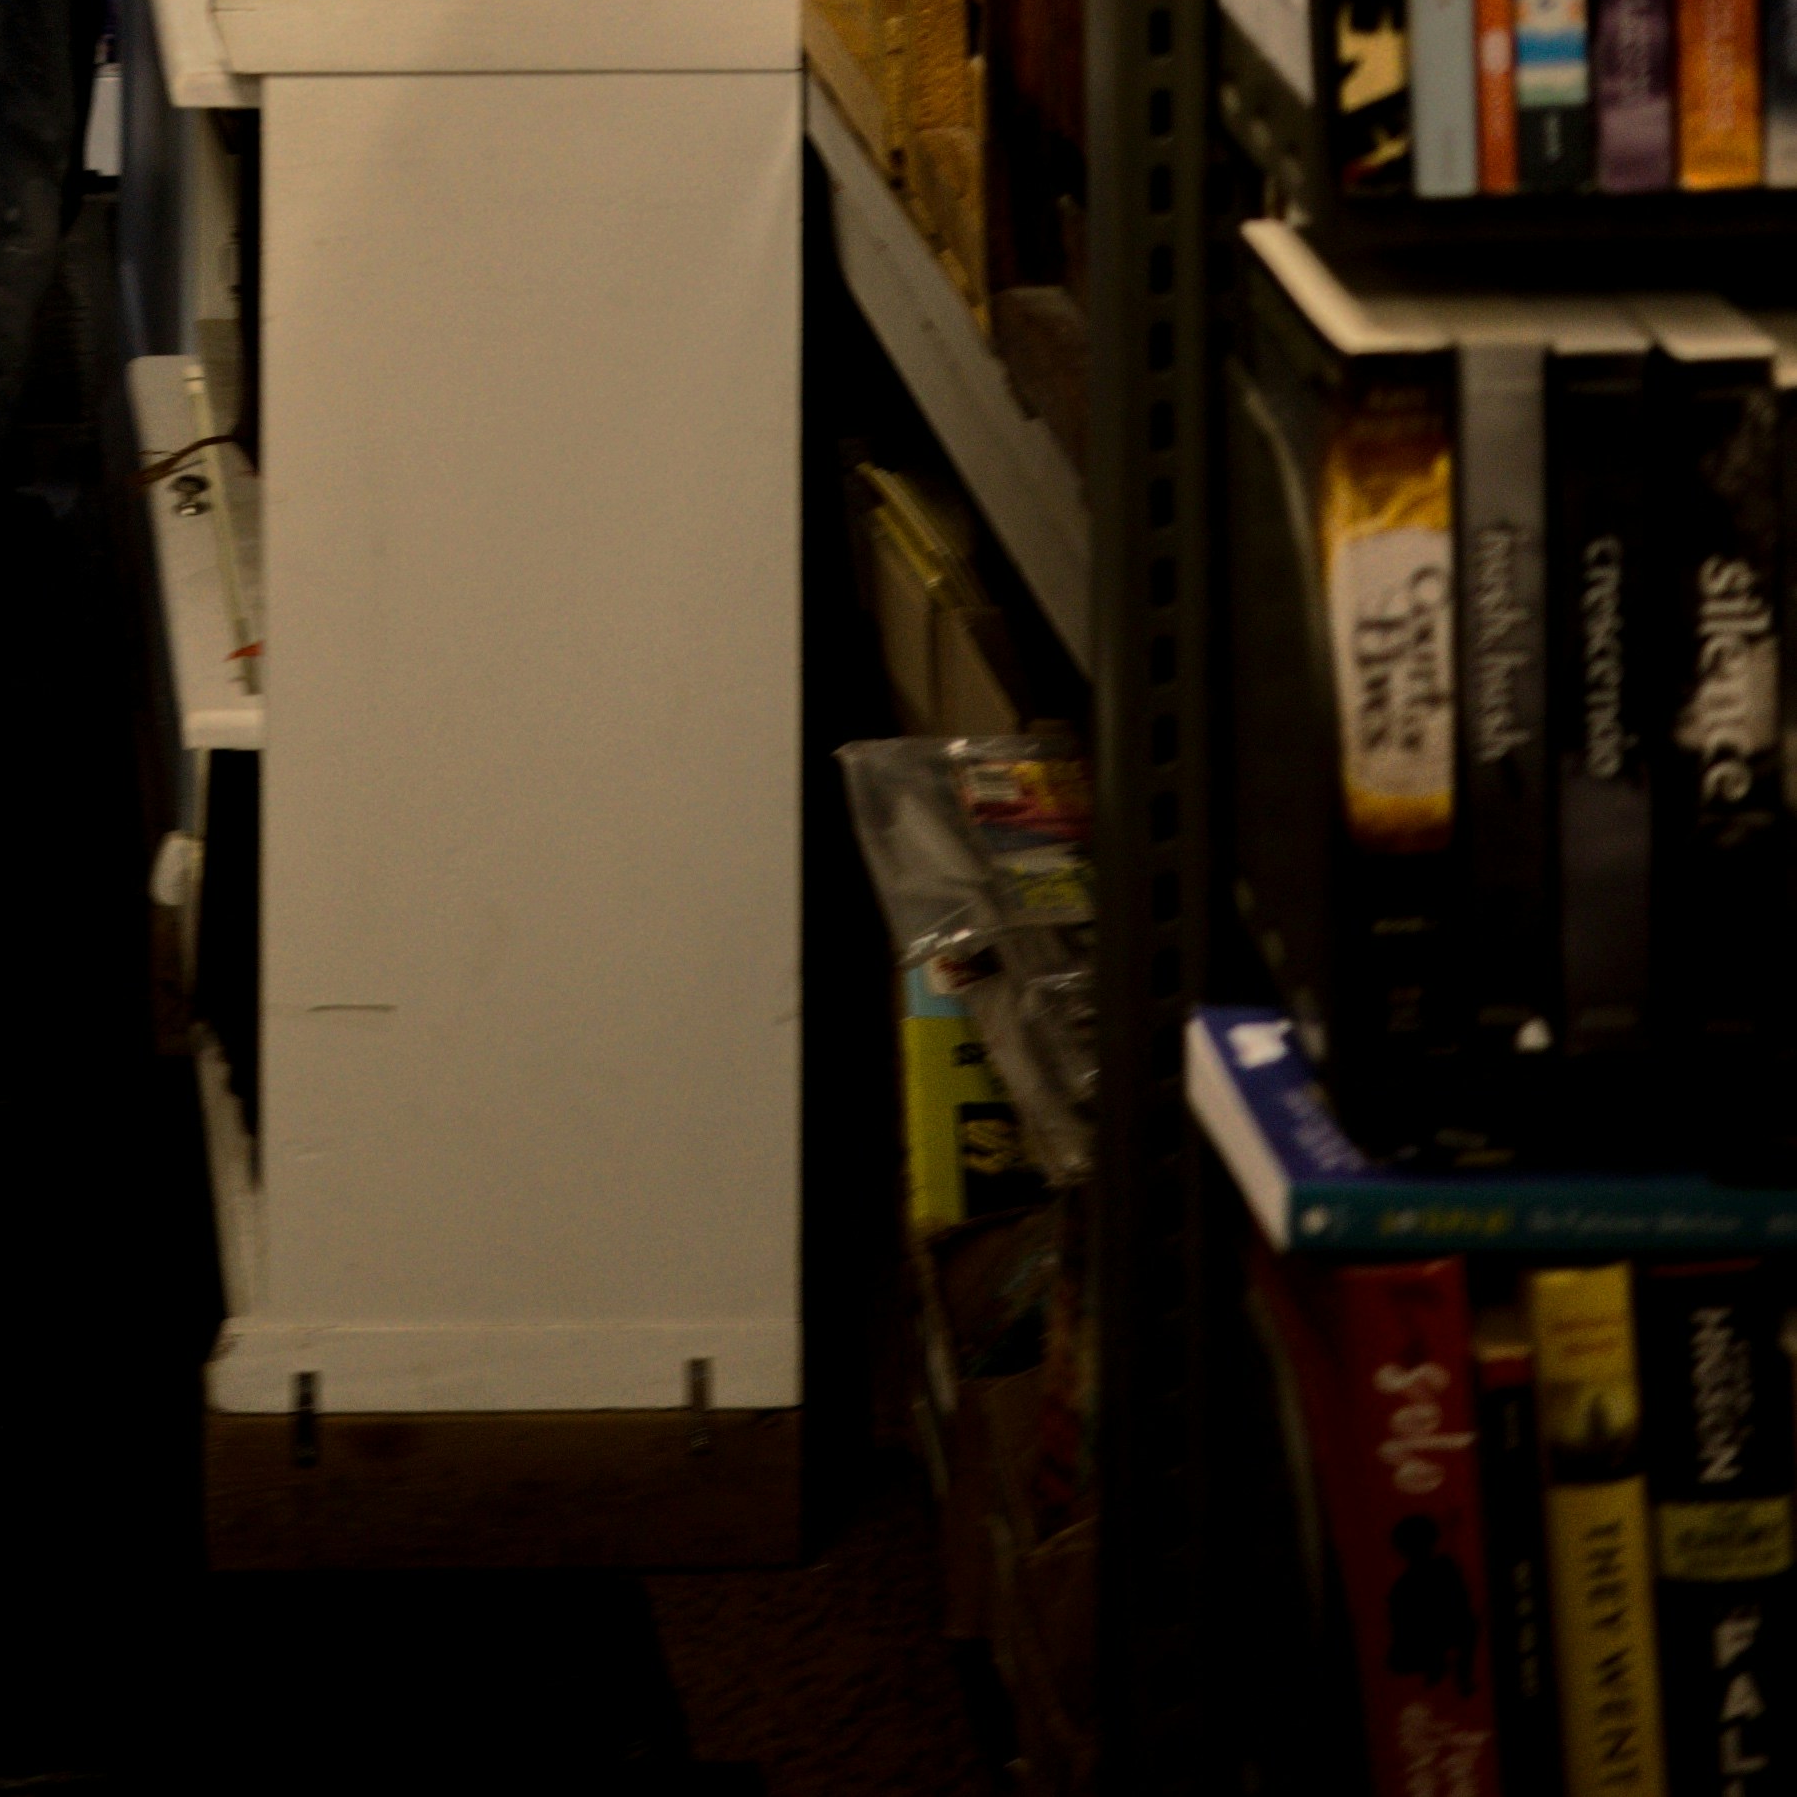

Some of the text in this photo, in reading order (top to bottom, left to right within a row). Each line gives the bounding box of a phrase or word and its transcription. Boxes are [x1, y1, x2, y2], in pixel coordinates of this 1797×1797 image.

[1355, 597, 1406, 754] Lions
[1403, 565, 1451, 708] Court
[1577, 533, 1636, 780] crescendo
[1695, 552, 1769, 807] silence
[1371, 1359, 1479, 1496] solo
[1581, 1519, 1646, 1789] THEY WENT
[1711, 1605, 1773, 1797] FAL
